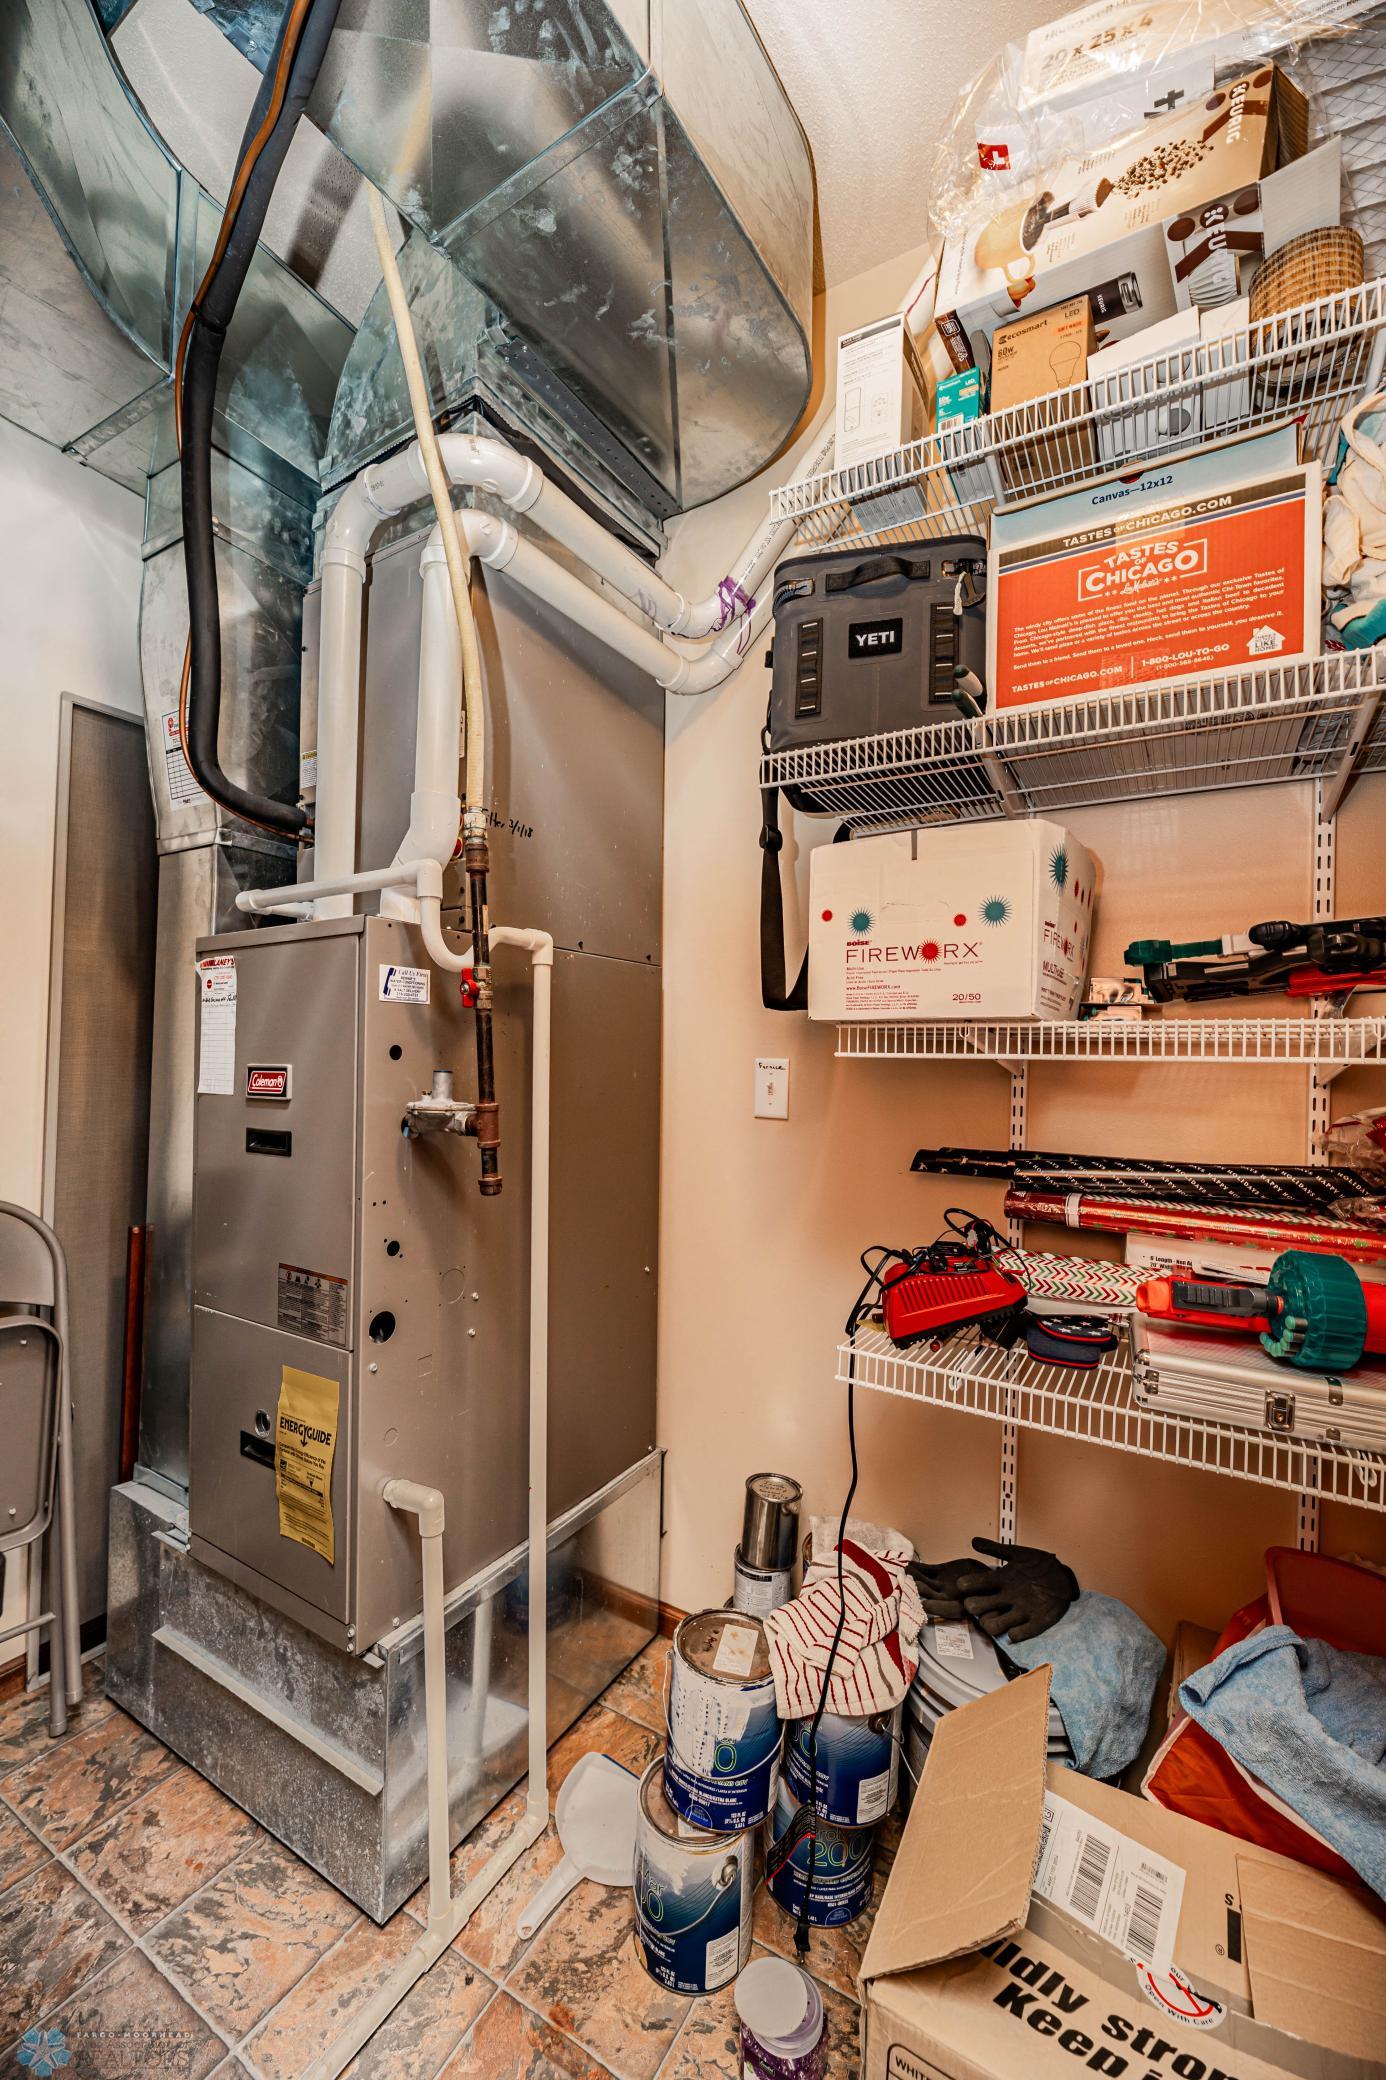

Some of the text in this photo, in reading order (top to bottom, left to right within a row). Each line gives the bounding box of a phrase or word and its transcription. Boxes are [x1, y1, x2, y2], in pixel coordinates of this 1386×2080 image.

[1041, 51, 1067, 70] 20
[1090, 27, 1116, 50] 25
[1226, 83, 1247, 144] KEURIG
[1064, 308, 1080, 319] LED
[1007, 319, 1048, 340] ecosmart
[1103, 541, 1179, 569] TASTES
[1134, 557, 1147, 565] OF
[1085, 549, 1199, 592] CHICAGO
[1026, 622, 1041, 631] windy
[1106, 604, 1122, 612] finest
[1182, 585, 1208, 596] Through
[1223, 575, 1252, 586] exclusive
[1255, 570, 1275, 579] Tastes
[1191, 589, 1220, 600] authentic
[1030, 630, 1066, 642] Chicago-style
[1069, 624, 1096, 634] deep-dish
[1169, 604, 1184, 612] dogs
[1203, 596, 1222, 604] Italian
[1253, 582, 1284, 593] decadent
[1127, 616, 1160, 627] restaurants
[1170, 611, 1187, 619] bring
[1201, 603, 1221, 611] Tastes
[1231, 595, 1258, 606] Chicago
[1059, 641, 1073, 649] pizza
[1086, 635, 1105, 643] variety
[1164, 618, 1182, 626] street
[1182, 628, 1197, 636] them
[1249, 612, 1275, 622] deserve
[855, 630, 895, 647] YETI
[1255, 640, 1275, 648] LIKE
[1142, 643, 1230, 667] 1-800-LOU-TO-GO
[952, 993, 981, 1001] 20/50
[252, 1074, 277, 1087] Coleman
[1227, 1169, 1260, 1195] HOLIDAYS
[1260, 1174, 1283, 1192] HAPPY
[1281, 1170, 1315, 1197] HOLIDAYS
[1315, 1175, 1339, 1194] HAPPY
[1337, 1172, 1370, 1196] HOLIDAY
[1156, 1256, 1172, 1264] Length
[279, 1416, 332, 1446] ENERGYGUIDE
[979, 1937, 1090, 2014] ildly
[1145, 1984, 1214, 2026] Open With Care
[993, 1982, 1129, 2078] Keep
[1100, 2013, 1239, 2080] stro
[896, 2055, 932, 2080] WHIT
